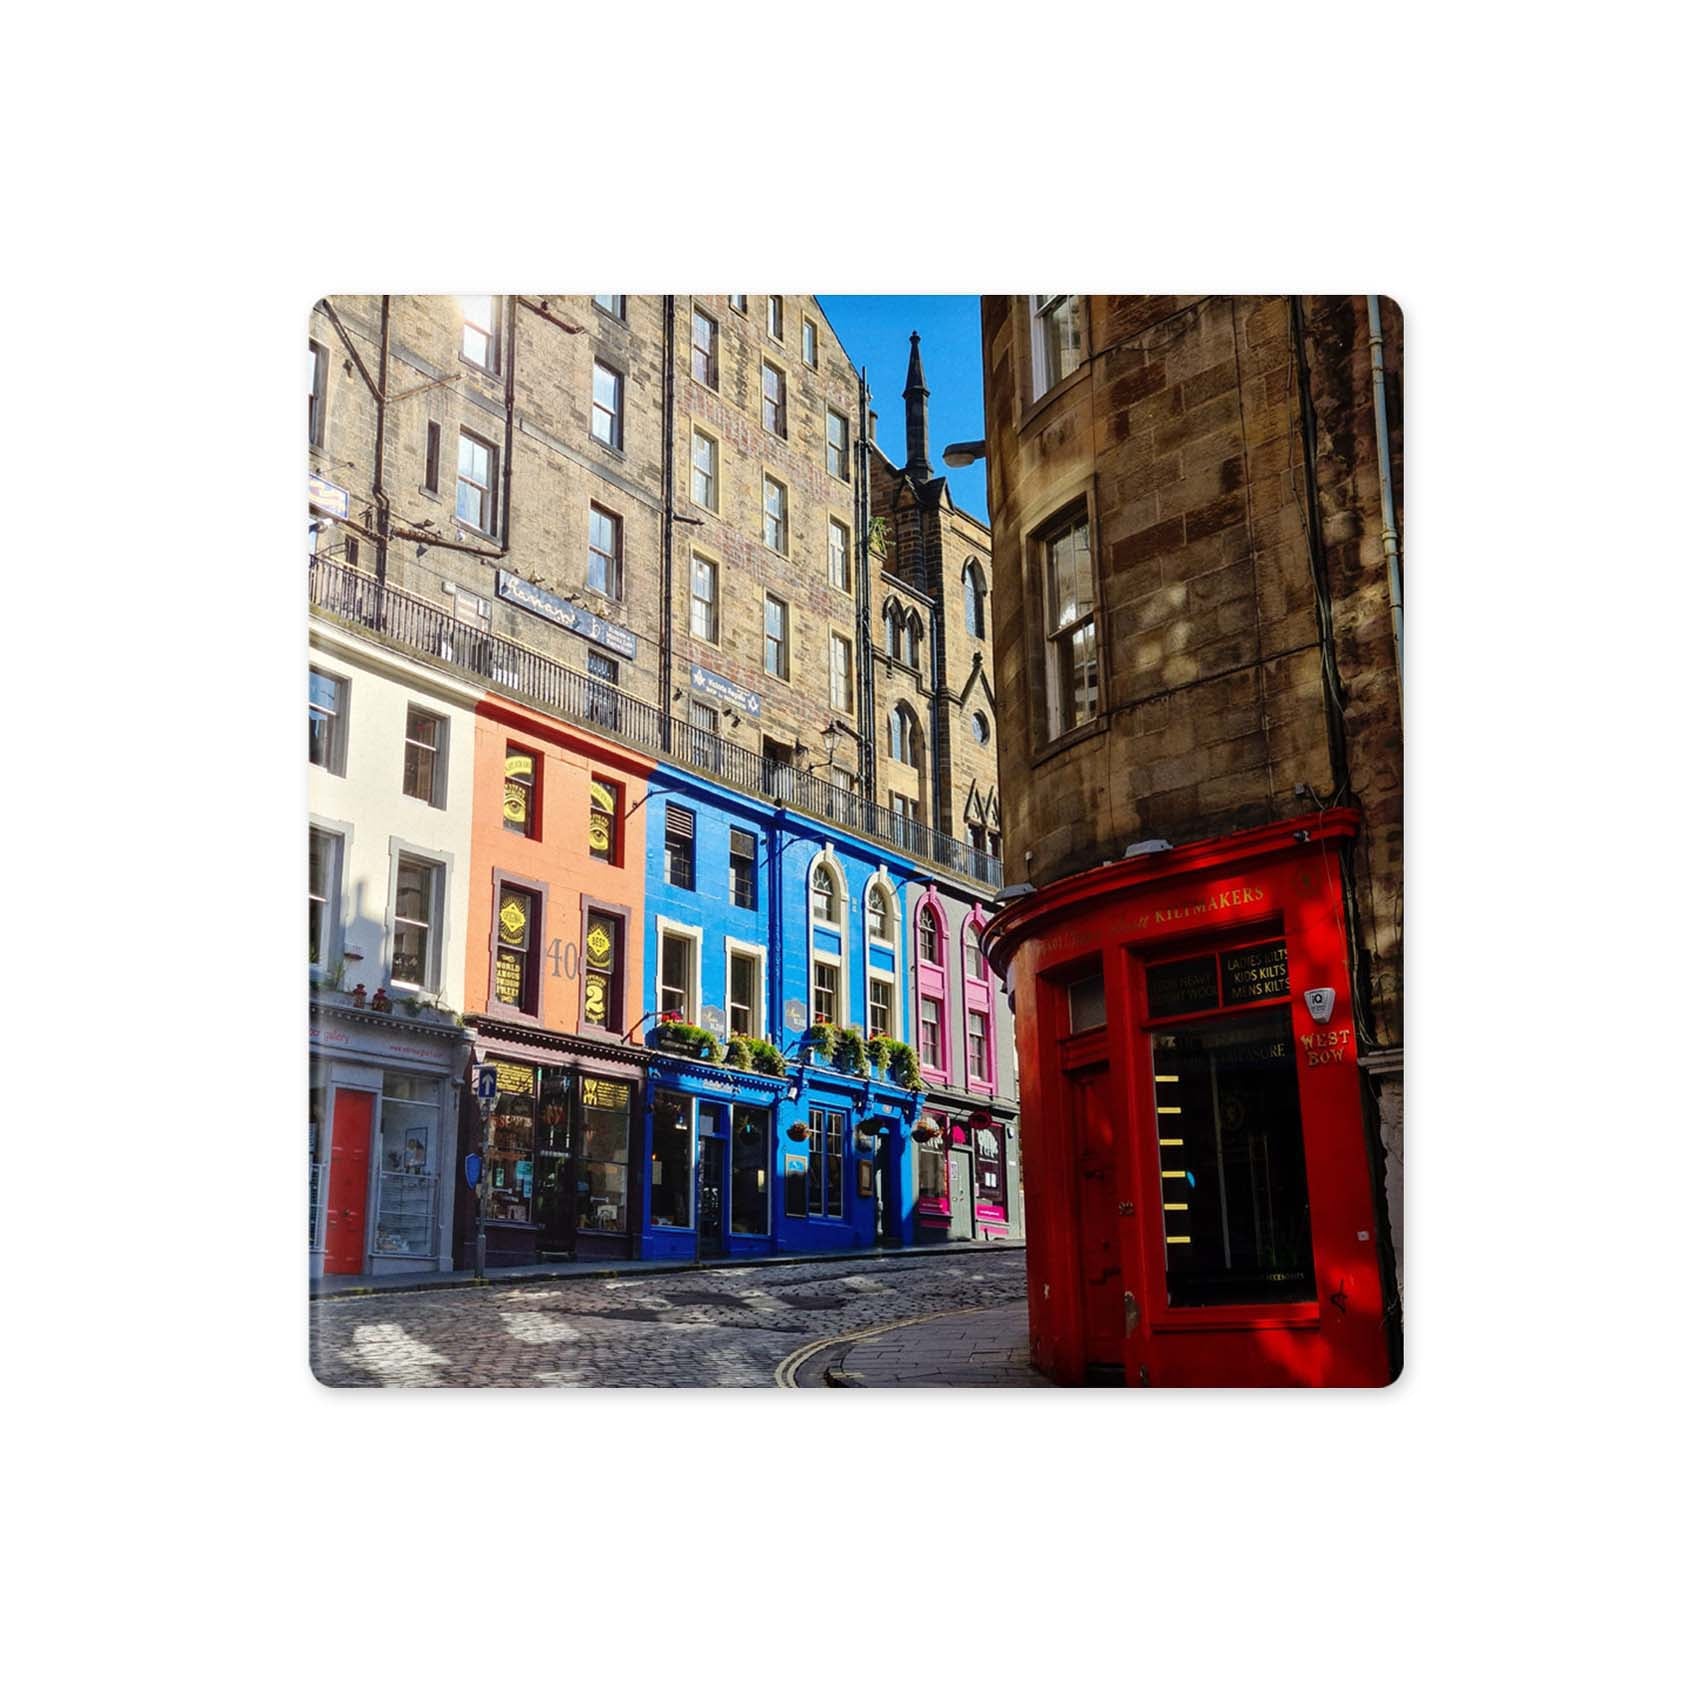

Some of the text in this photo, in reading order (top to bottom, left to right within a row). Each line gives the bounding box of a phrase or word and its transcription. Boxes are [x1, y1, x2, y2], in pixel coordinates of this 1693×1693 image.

[1153, 886, 1264, 924] KILTMAKERS
[546, 938, 577, 981] 40
[1232, 963, 1286, 984] KIDS KILTS
[1264, 977, 1292, 994] KILTS
[1300, 1029, 1350, 1050] WEST
[1307, 1047, 1344, 1067] BOW
